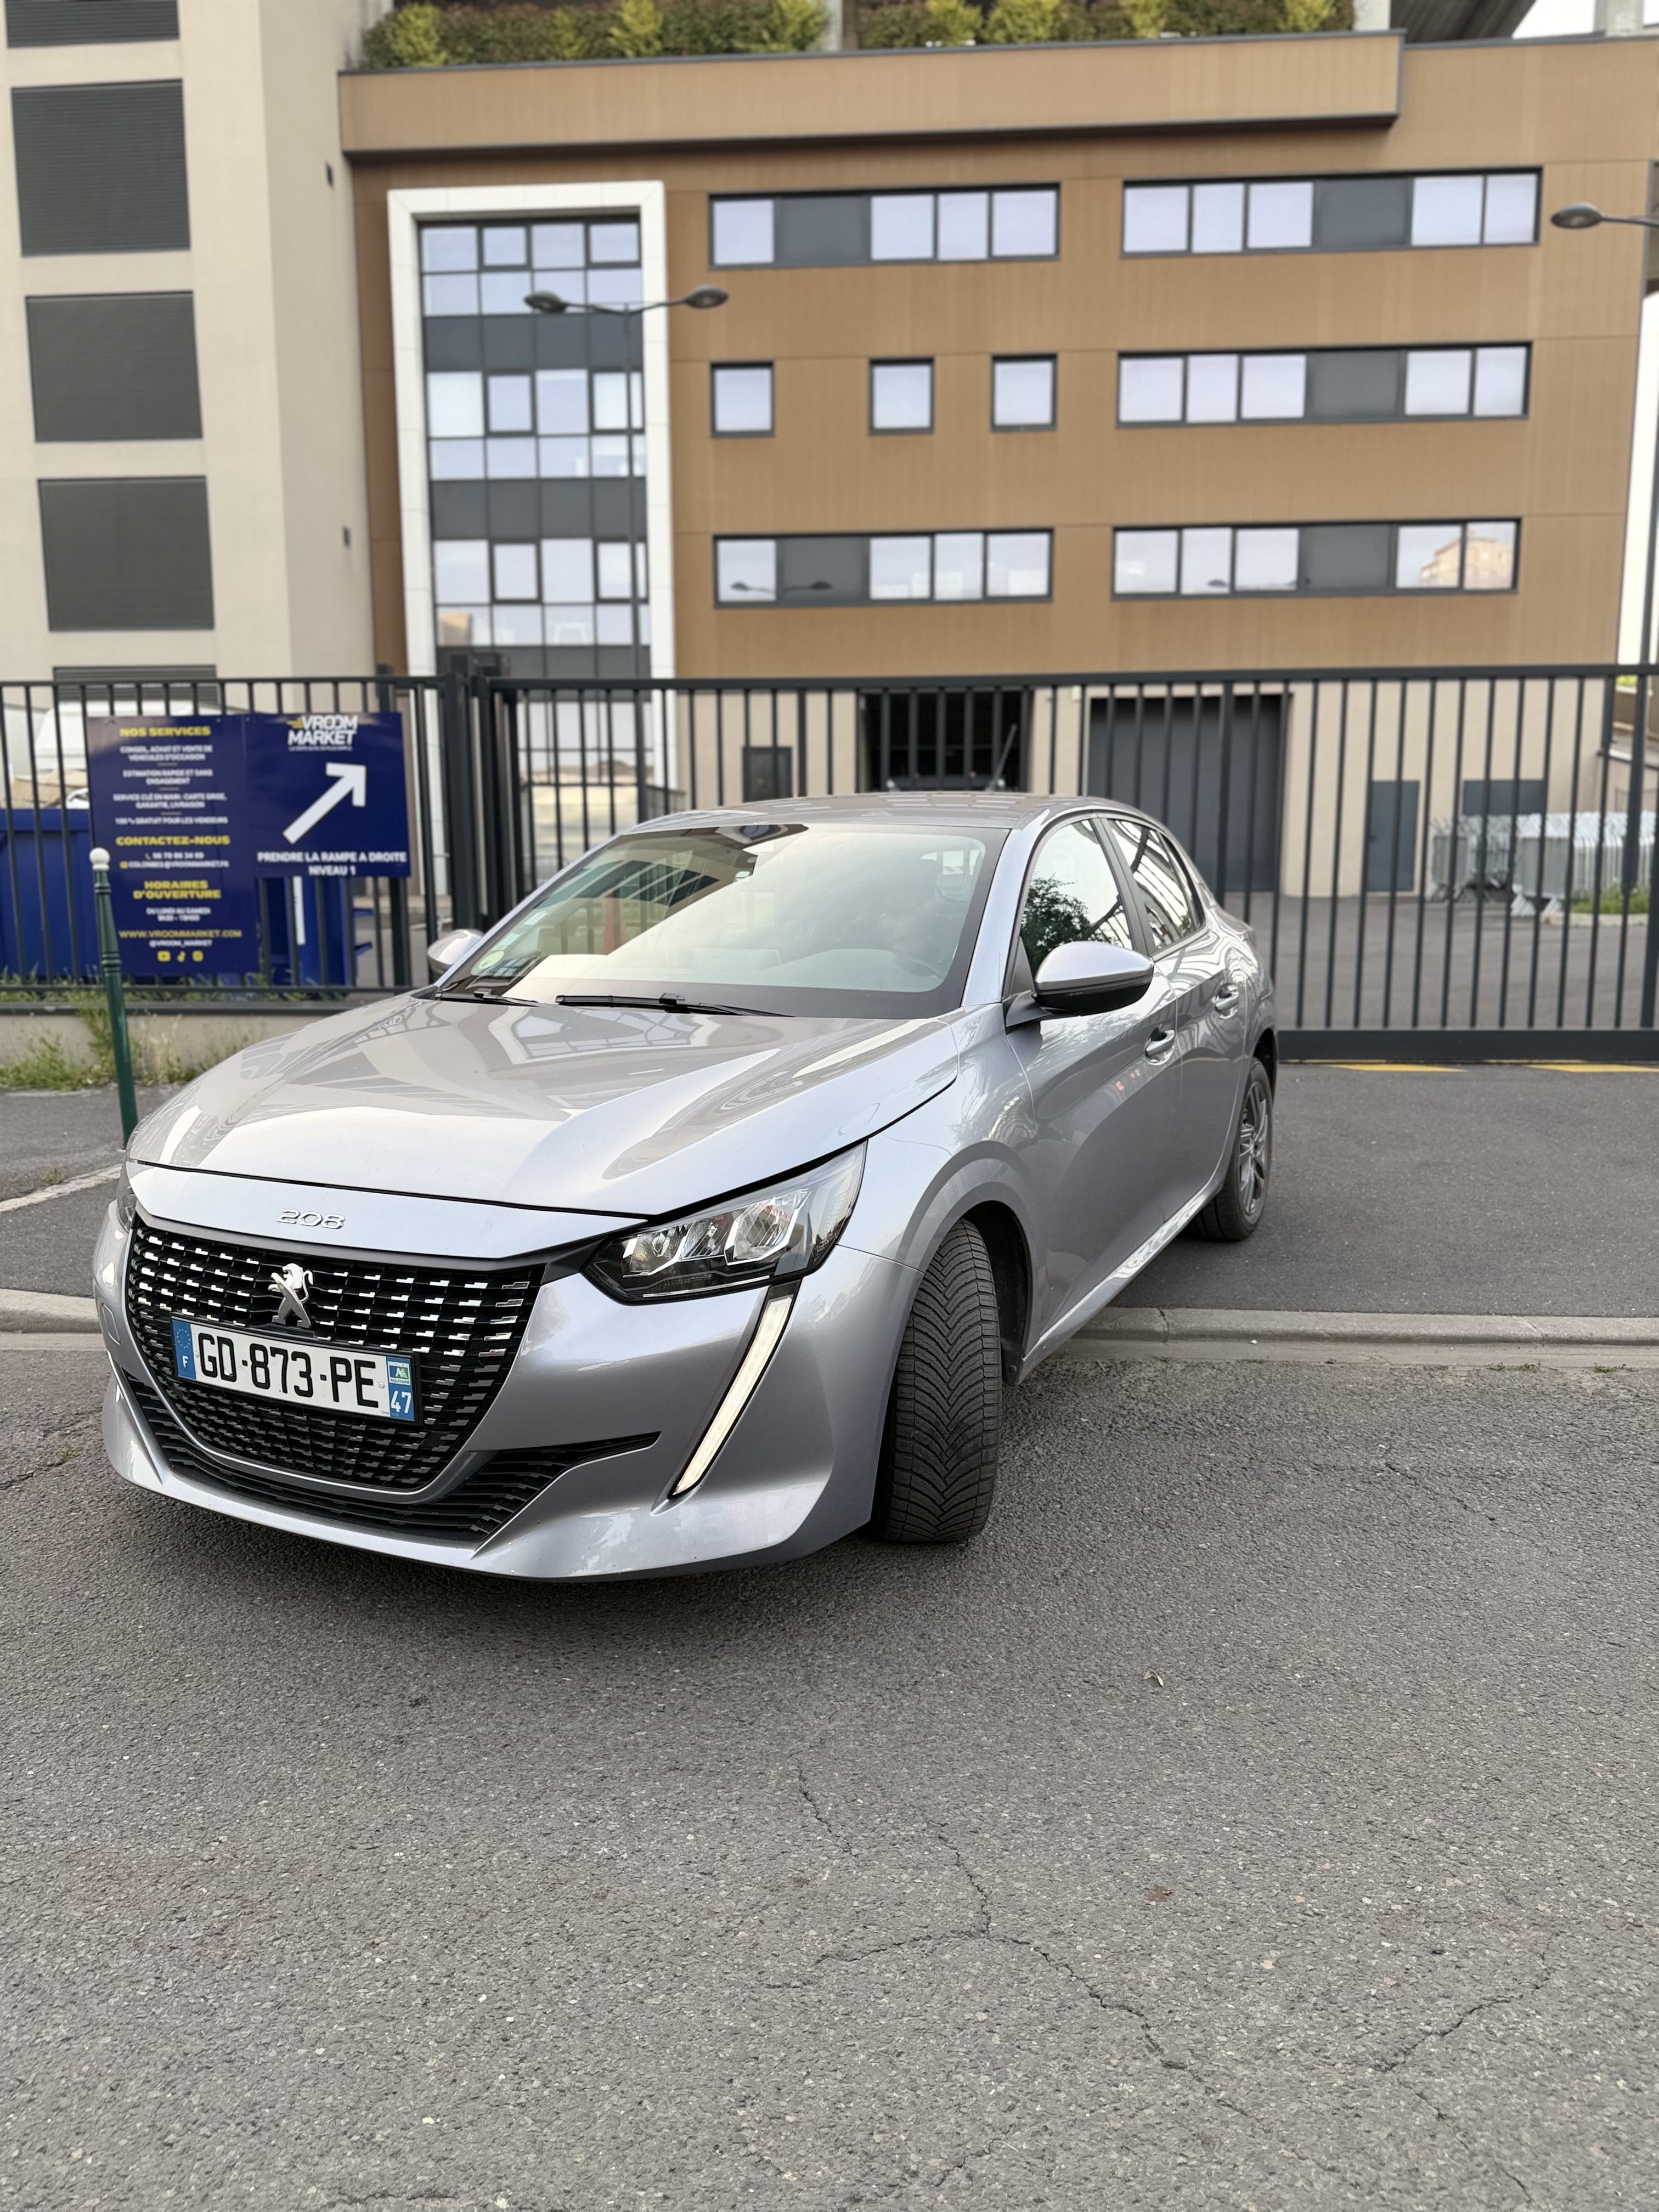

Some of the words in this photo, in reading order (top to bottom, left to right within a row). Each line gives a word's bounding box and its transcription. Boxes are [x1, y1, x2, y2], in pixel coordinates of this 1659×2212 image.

[301, 715, 358, 730] VROOM
[120, 727, 146, 737] NOS
[149, 726, 211, 737] SERVICES
[287, 730, 357, 746] MARKET
[116, 836, 230, 845] CONTACTEZ-NOUS
[257, 851, 303, 862] PRENDRE
[305, 851, 320, 862] LA
[321, 851, 356, 862] RAMPE
[359, 851, 367, 862] A
[369, 851, 407, 862] DROITE
[308, 865, 348, 876] NIVEAU
[350, 865, 356, 876] 1
[144, 880, 208, 889] HORAIRES
[133, 890, 222, 899] D'OUVERTURE
[276, 1209, 345, 1229] 208
[182, 1355, 189, 1368] F
[391, 1390, 412, 1414] 47
